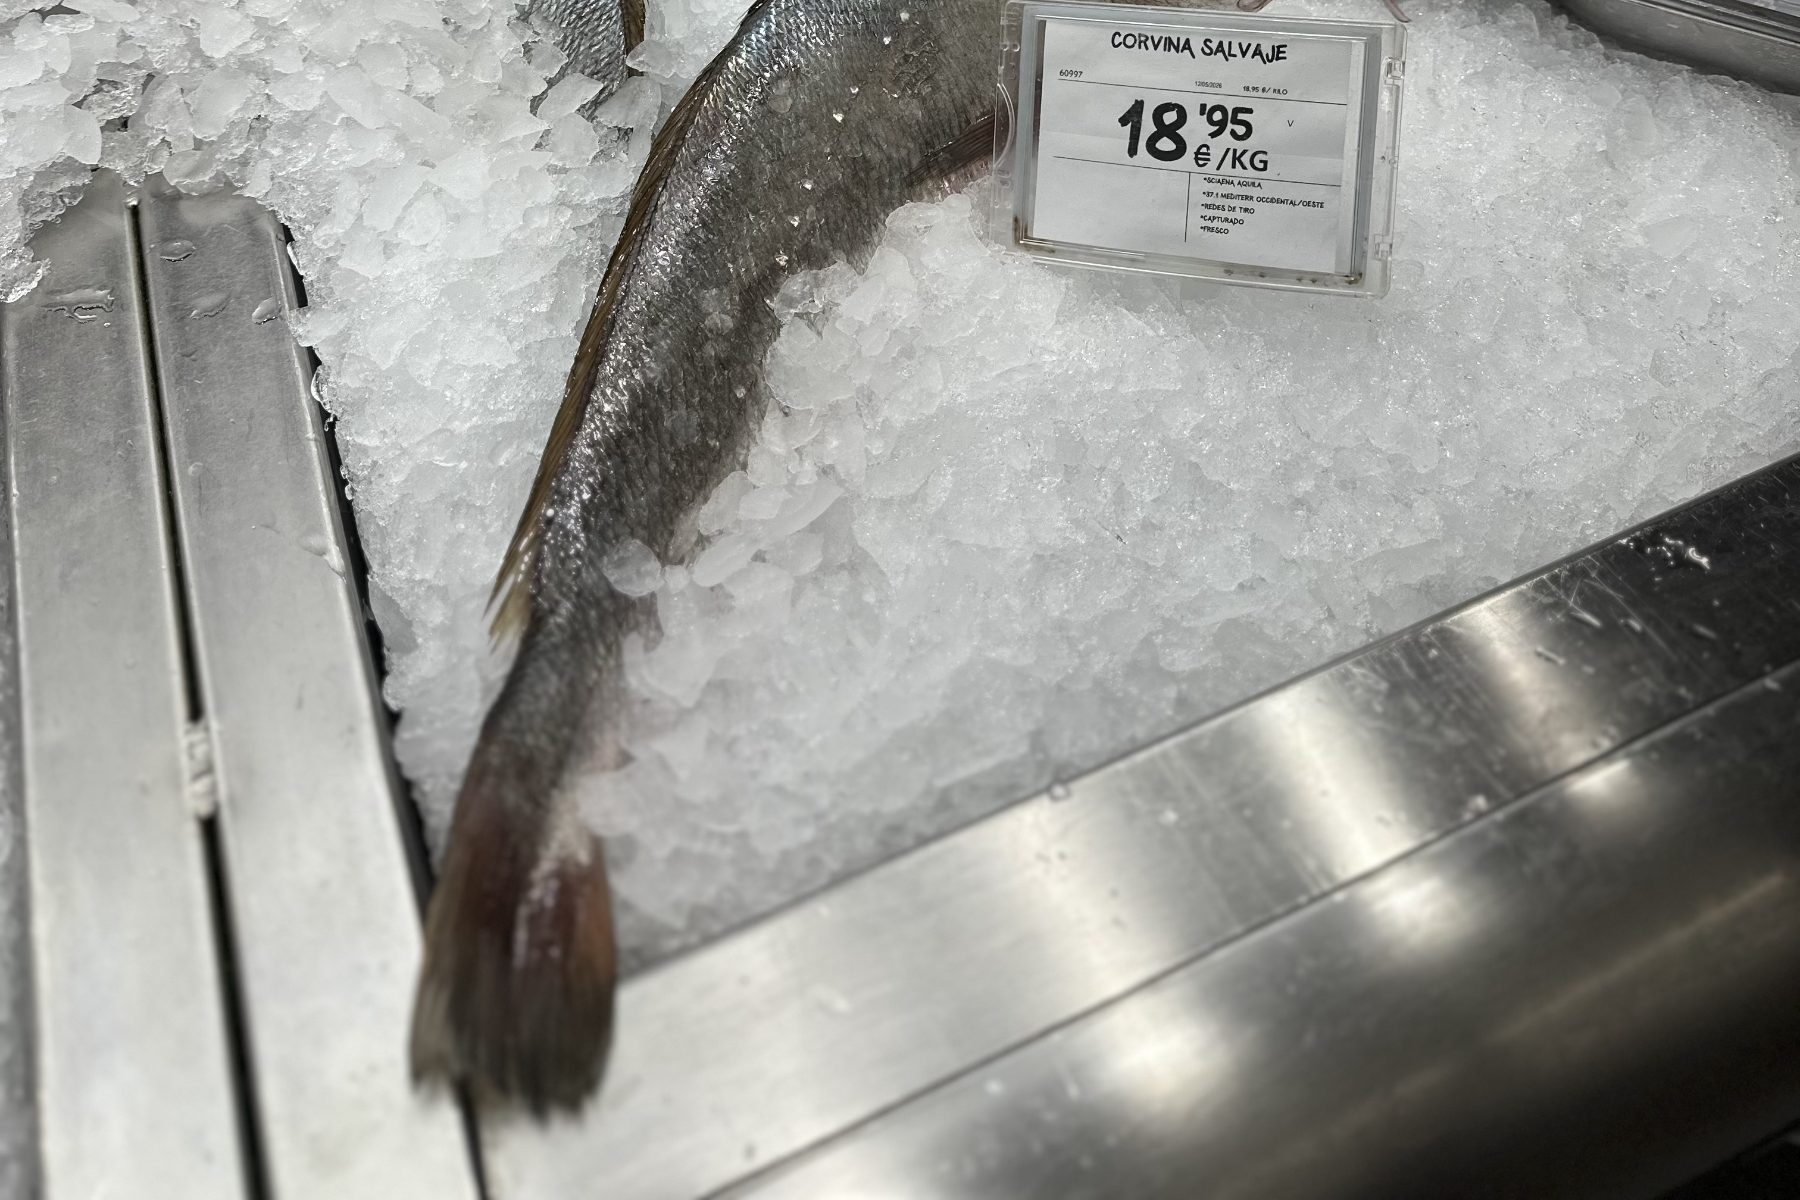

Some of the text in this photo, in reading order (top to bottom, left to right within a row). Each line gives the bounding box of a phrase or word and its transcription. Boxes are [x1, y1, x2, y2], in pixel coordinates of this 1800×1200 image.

[1111, 31, 1288, 64] CORVINA SALVAJE
[1059, 69, 1083, 78] 60997
[1237, 180, 1263, 189] AQUILA
[1220, 192, 1254, 202] MEDITERR
[1238, 206, 1255, 214] TIRO
